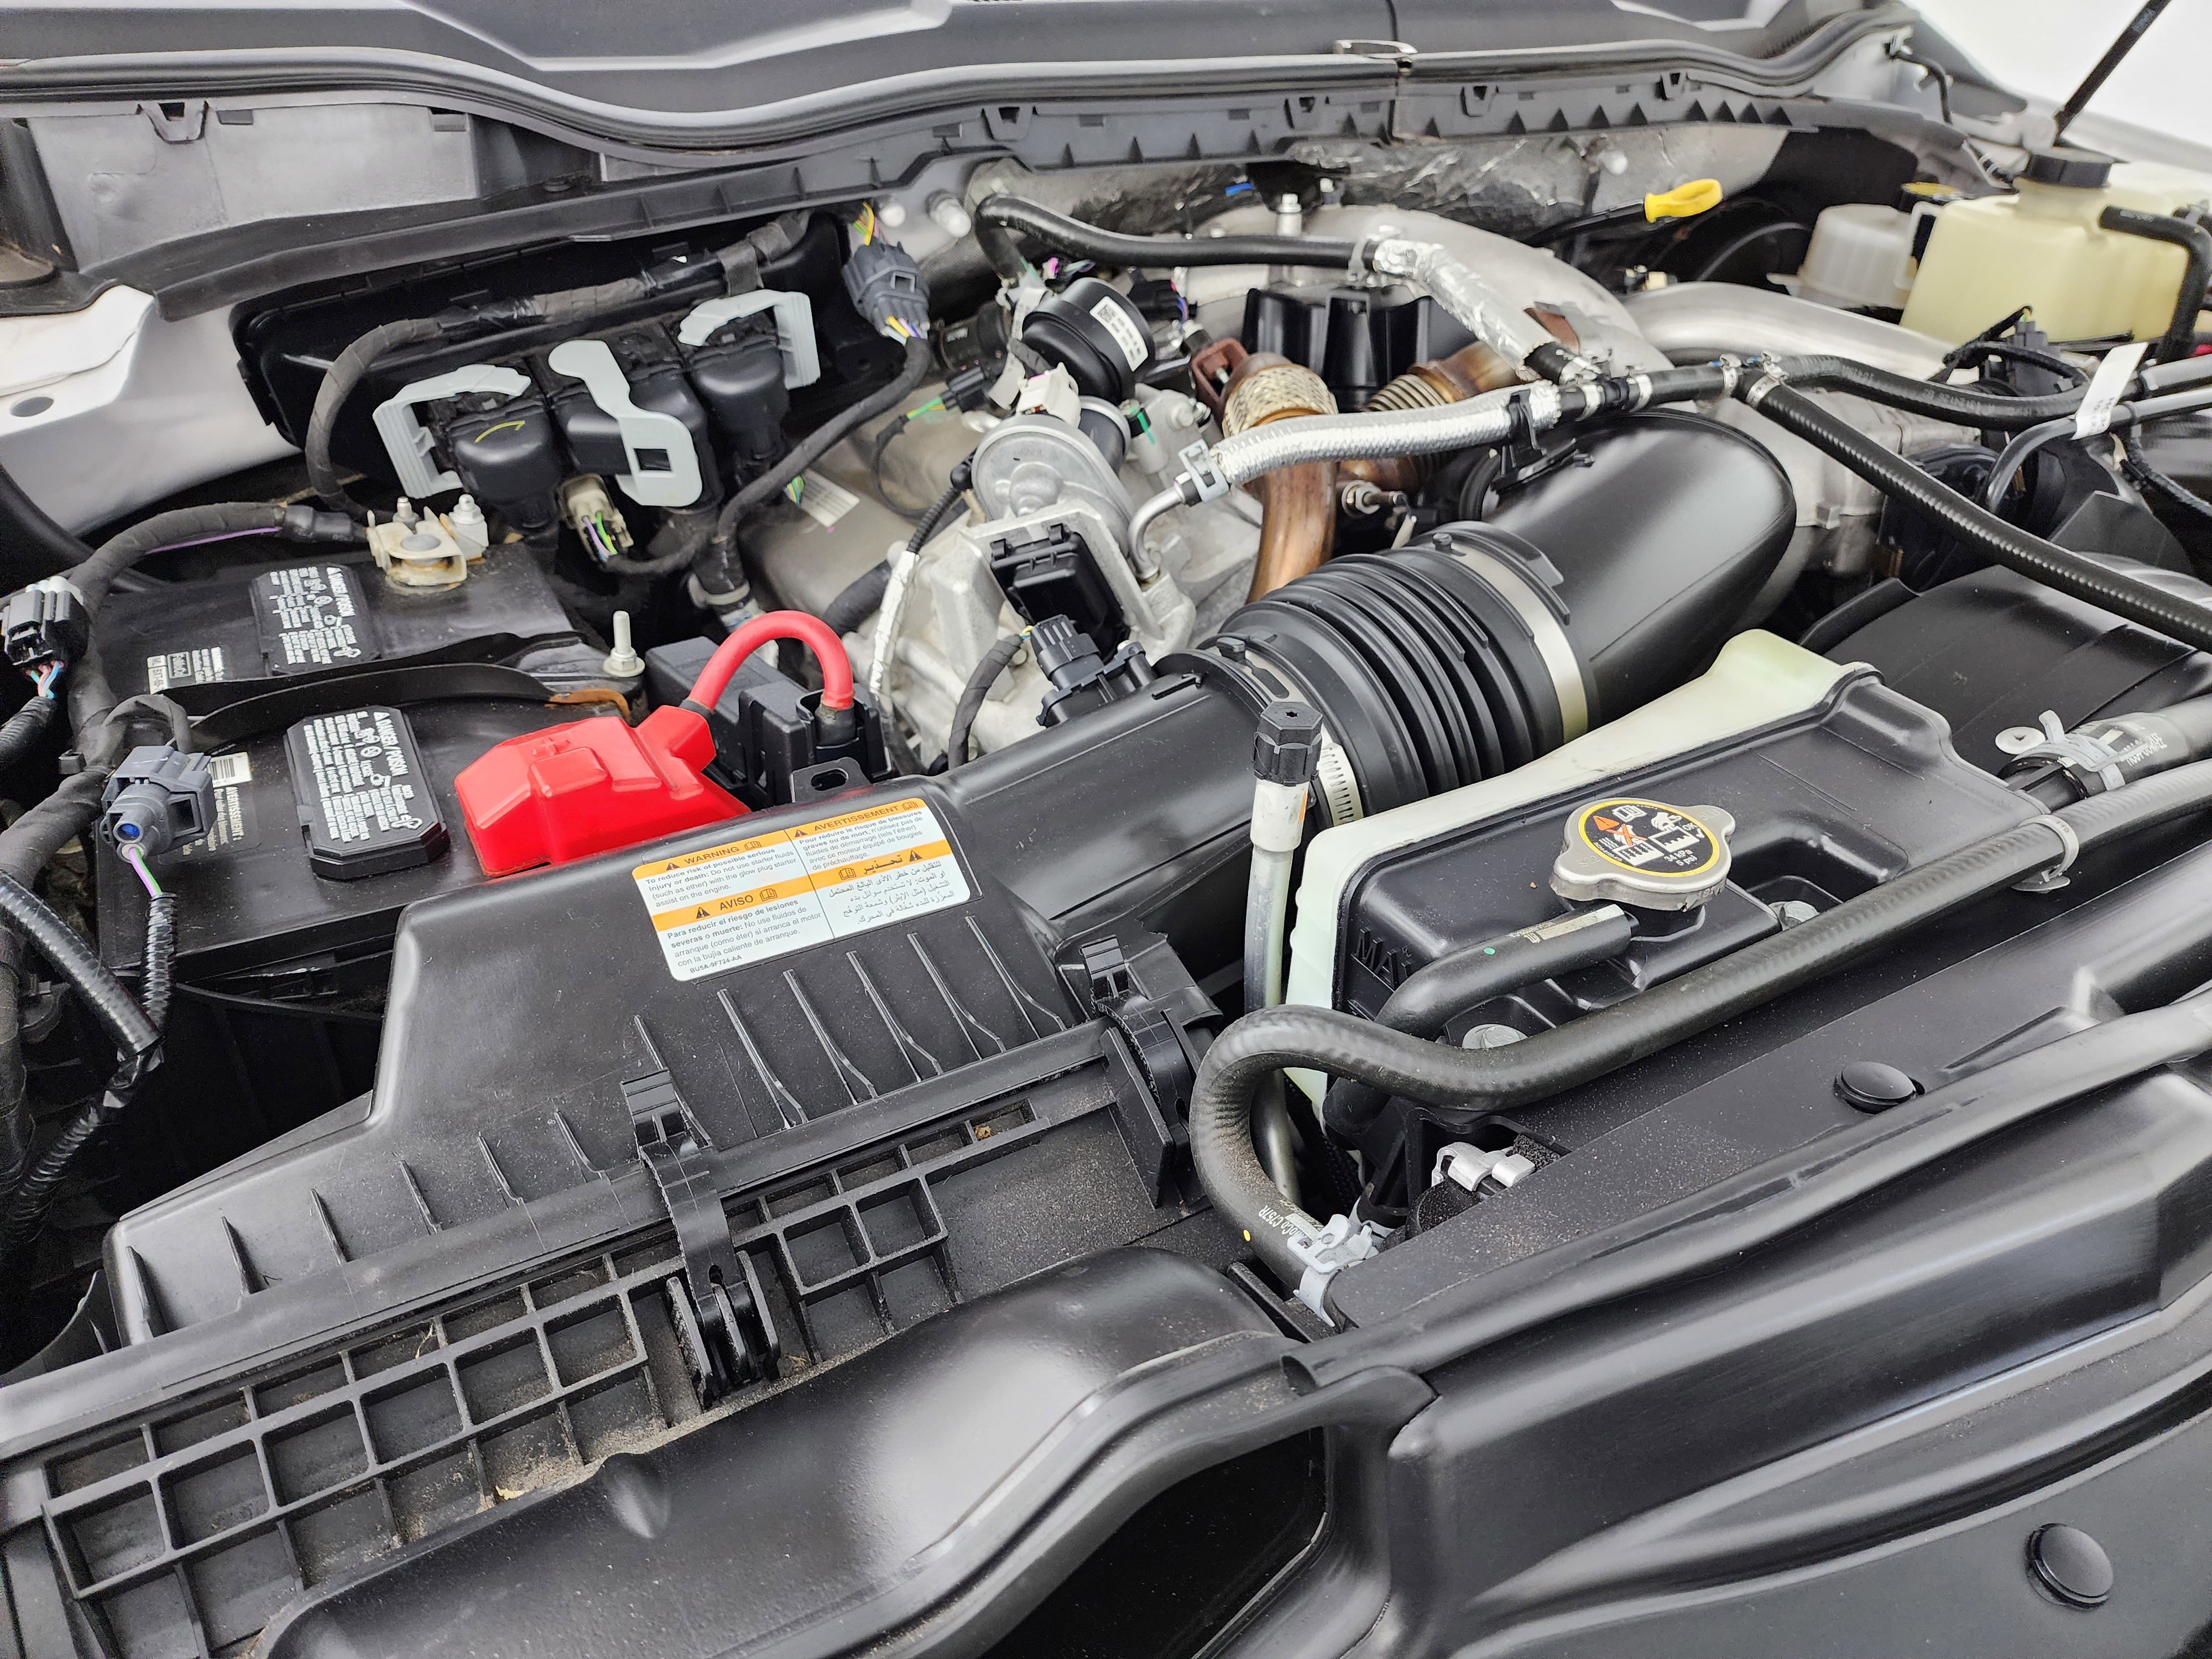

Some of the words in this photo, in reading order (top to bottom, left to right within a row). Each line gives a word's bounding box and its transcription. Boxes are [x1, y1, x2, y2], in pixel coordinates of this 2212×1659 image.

[378, 719, 409, 777] DANGER/POISON
[815, 805, 898, 831] AVERTISSEMENT
[818, 831, 844, 839] réduire
[854, 822, 877, 831] risque
[888, 811, 922, 822] blessures
[1682, 822, 1698, 831] OK
[802, 841, 827, 851] graves
[805, 847, 828, 857] fluides
[840, 835, 877, 848] démarrage
[837, 846, 860, 855] moteur
[862, 839, 885, 849] équipé
[895, 831, 922, 841] bougies
[1673, 849, 1693, 858] kPa
[658, 872, 685, 881] reduce
[713, 856, 745, 868] possible
[747, 849, 775, 858] serious
[684, 847, 739, 864] WARNING
[1683, 854, 1698, 865] psi
[652, 890, 673, 900] (such
[686, 880, 707, 890] ether)
[739, 869, 755, 878] glow
[757, 864, 773, 873] plug
[774, 858, 796, 867] starter
[684, 873, 709, 882] death:
[751, 856, 773, 865] starter
[656, 897, 677, 907] assist
[704, 884, 731, 894] engine.
[720, 895, 753, 910] AVISO
[667, 930, 686, 938] Para
[688, 921, 716, 933] reducir
[728, 912, 753, 922] riesgo
[765, 900, 798, 912] lesiones
[671, 936, 703, 948] severas
[712, 925, 743, 937] muerte:
[674, 944, 708, 957] arranque
[711, 937, 734, 948] (como
[735, 930, 753, 940] éter)
[763, 921, 791, 932] arranca
[800, 912, 821, 922] motor
[723, 942, 752, 953] caliente
[765, 929, 800, 942] arranque.
[1355, 926, 1412, 991] MA
[1258, 1204, 1284, 1227] C757R
